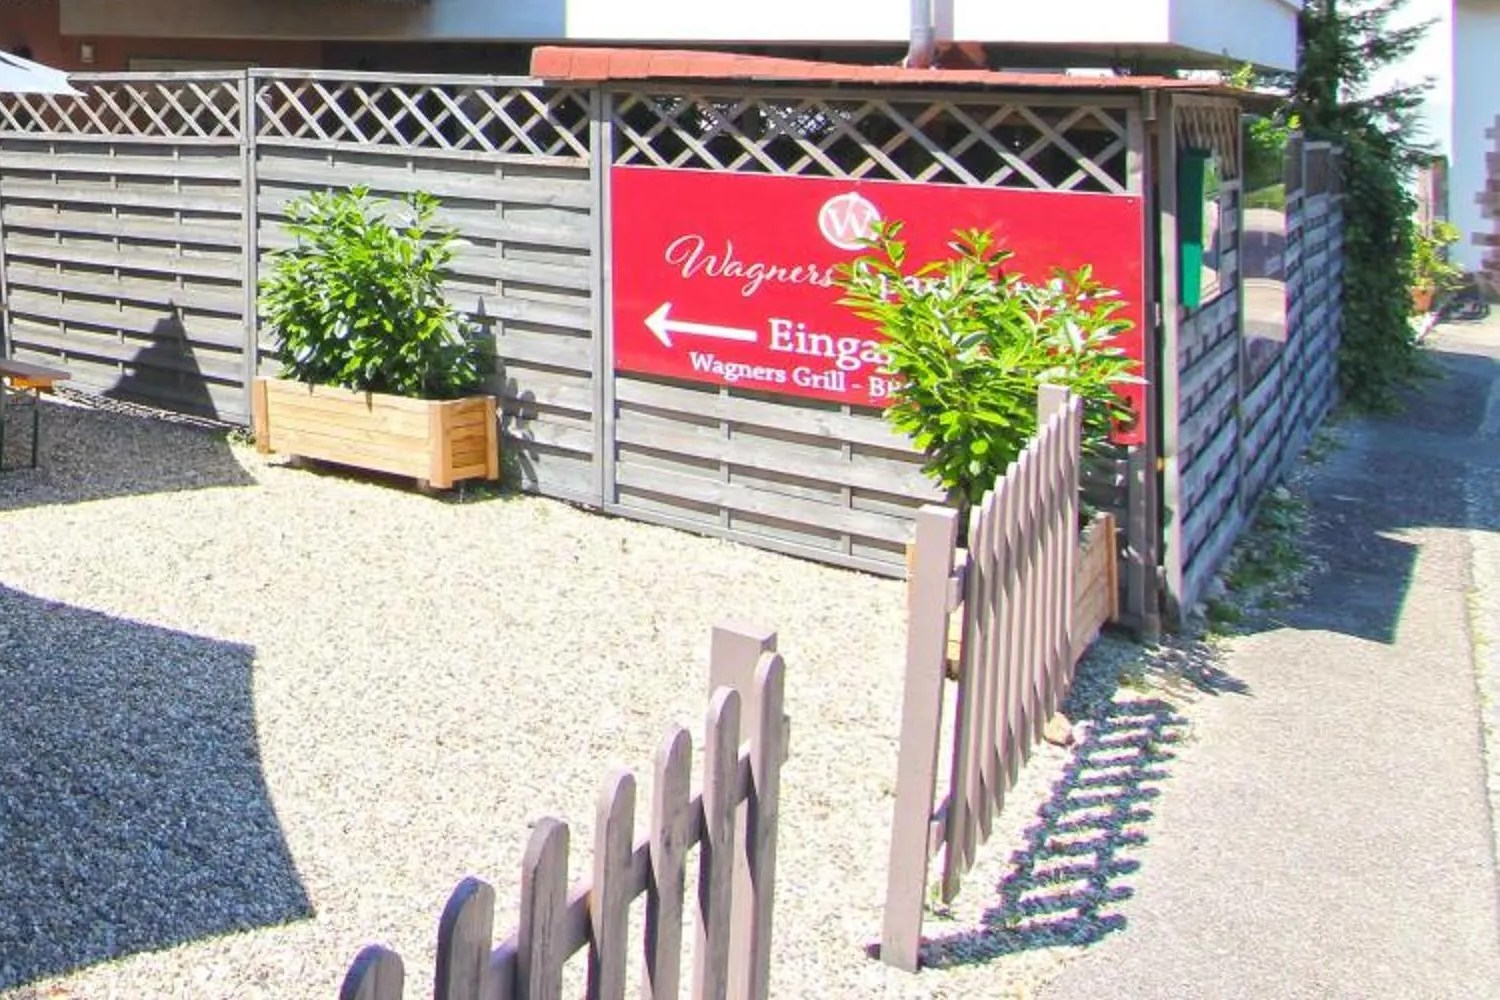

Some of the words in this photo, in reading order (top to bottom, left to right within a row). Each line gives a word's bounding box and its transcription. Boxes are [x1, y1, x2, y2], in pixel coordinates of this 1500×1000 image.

[825, 193, 874, 239] W
[665, 234, 837, 297] Wagners
[767, 316, 896, 372] Einga
[688, 351, 787, 382] Wagners
[792, 366, 847, 392] Grill
